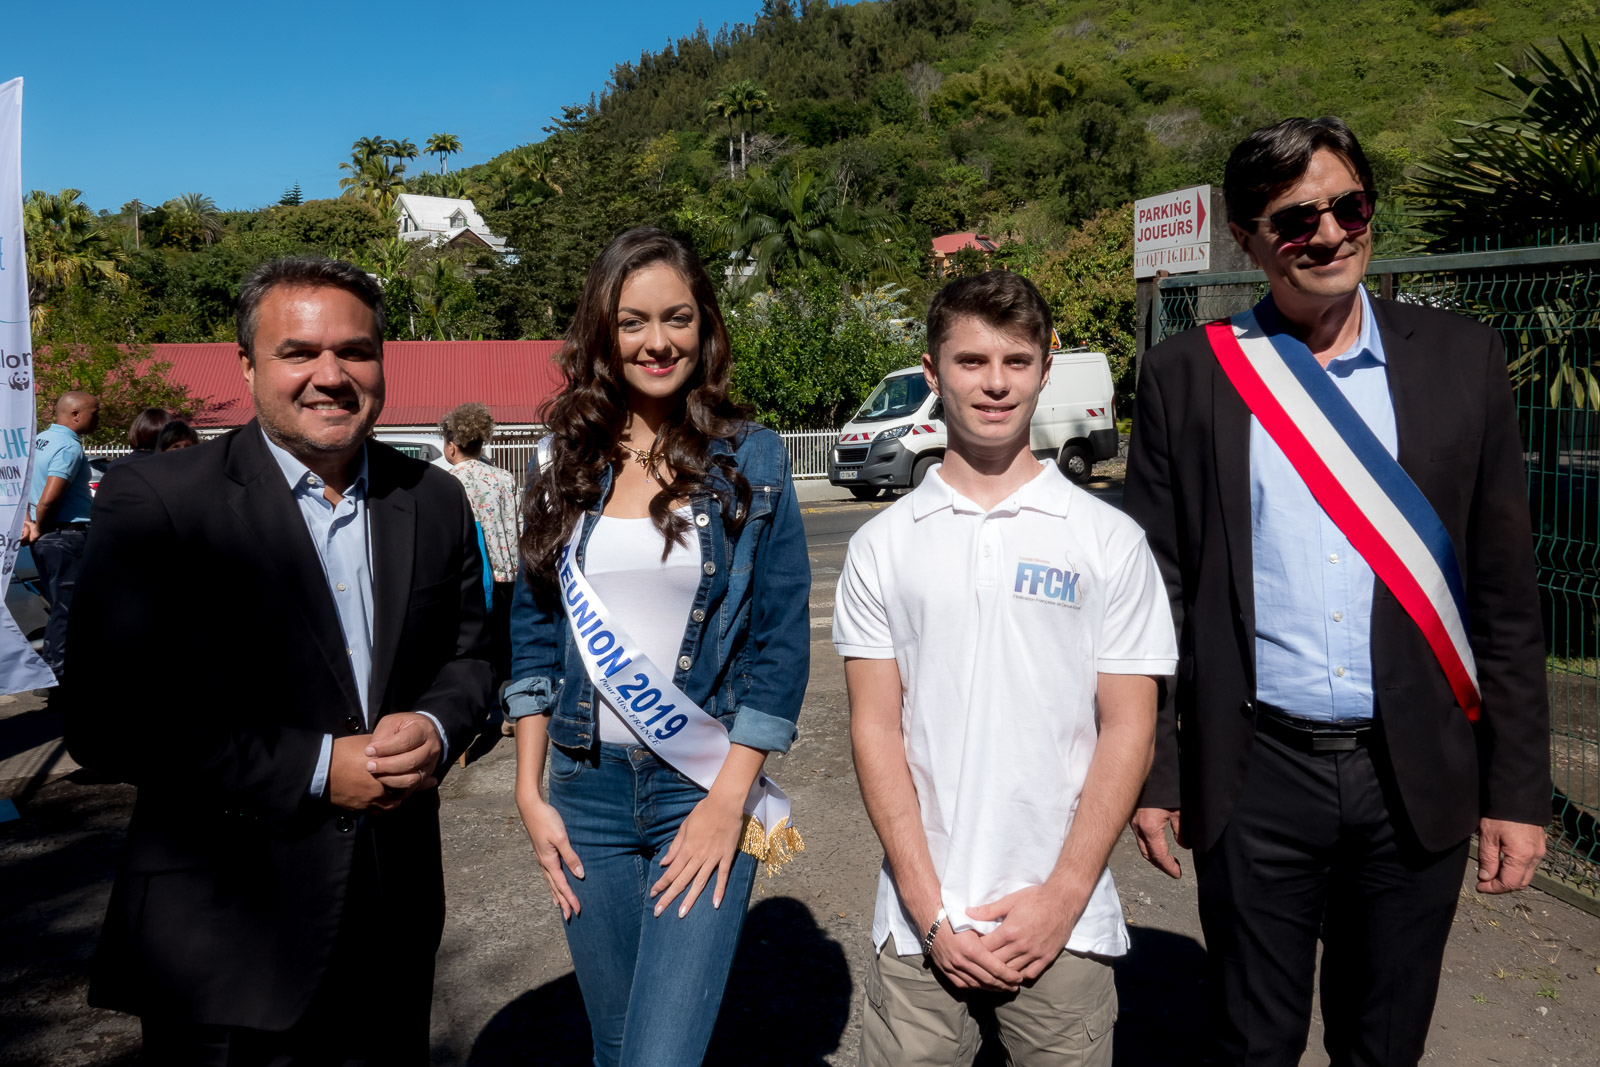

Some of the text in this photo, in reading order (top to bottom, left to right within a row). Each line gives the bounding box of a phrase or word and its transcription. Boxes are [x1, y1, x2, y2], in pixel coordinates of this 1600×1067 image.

[1137, 219, 1193, 242] JOUEURS
[1139, 200, 1191, 223] PARKING
[1014, 562, 1080, 603] FFCK
[600, 678, 662, 746] Pour Miss FRANCE
[616, 673, 688, 740] 2019
